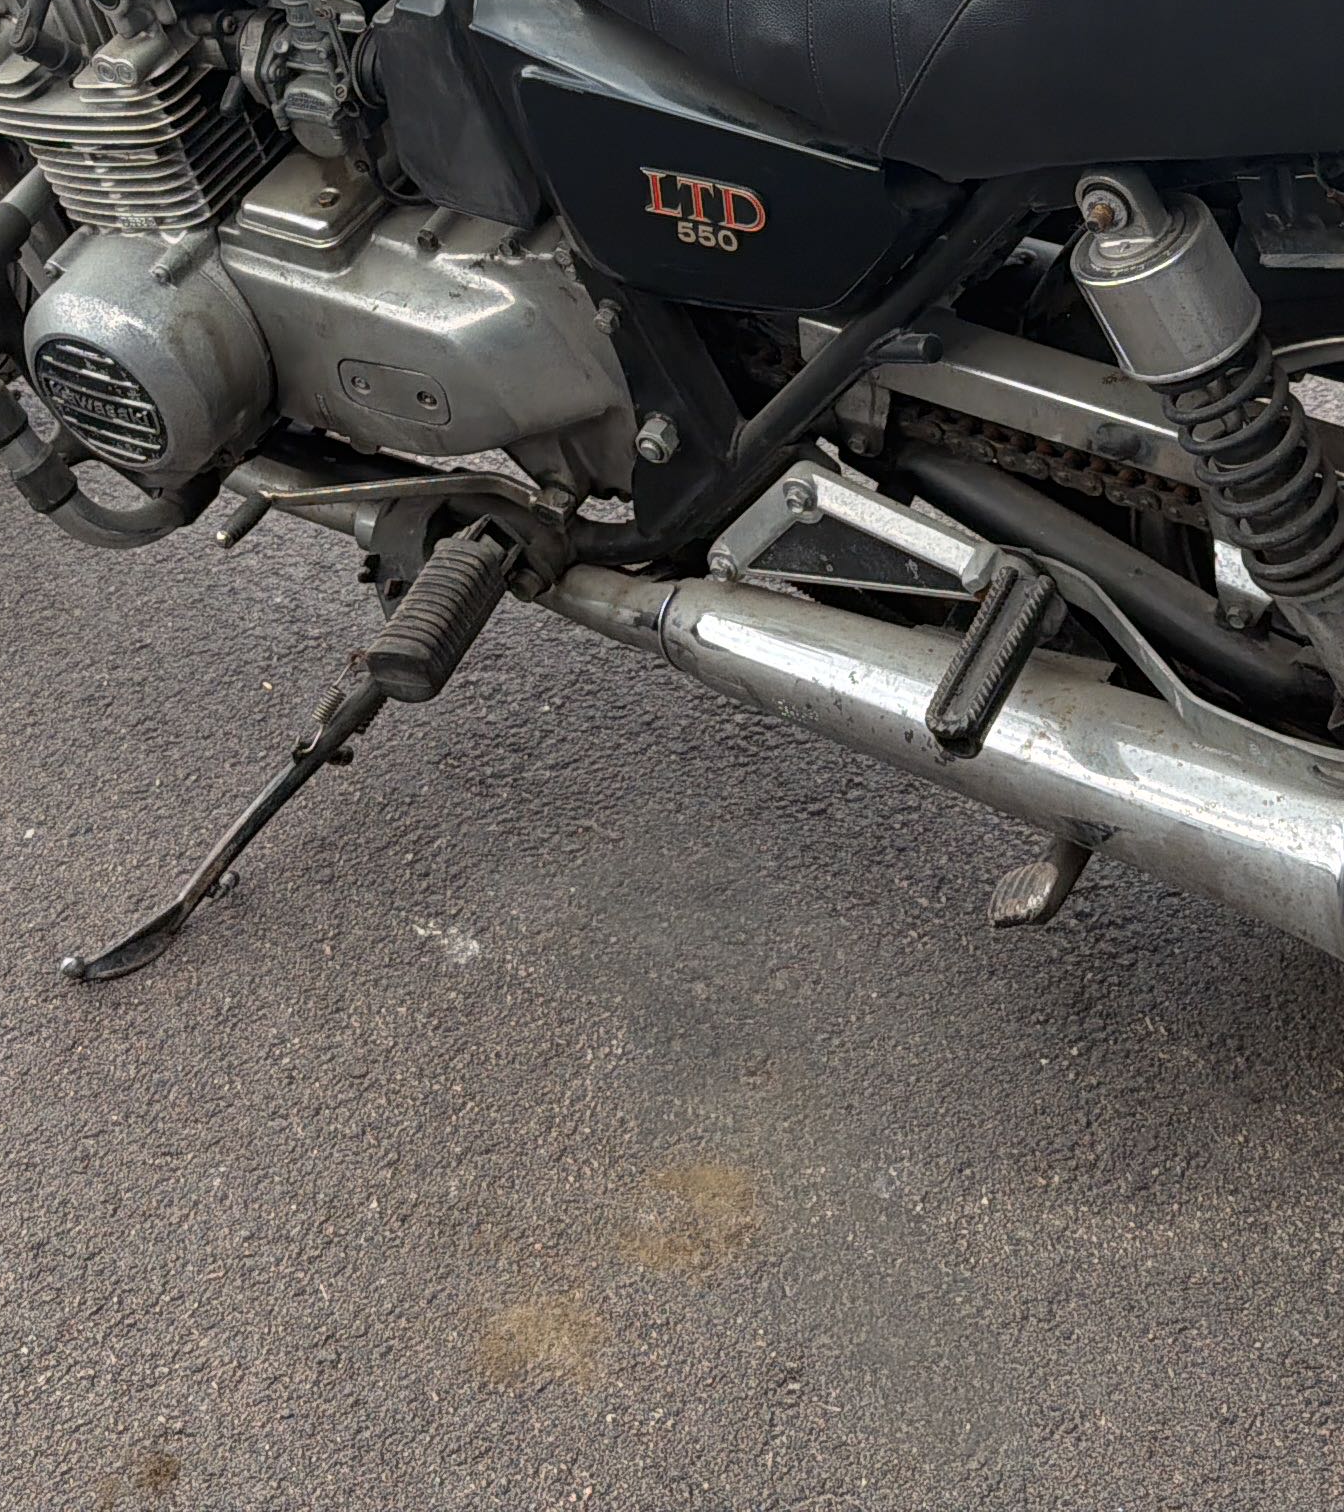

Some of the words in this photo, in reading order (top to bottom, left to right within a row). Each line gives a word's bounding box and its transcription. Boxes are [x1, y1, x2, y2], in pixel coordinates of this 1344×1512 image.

[640, 166, 766, 232] LTD
[677, 220, 738, 252] 550
[49, 380, 151, 426] Kawasaki
